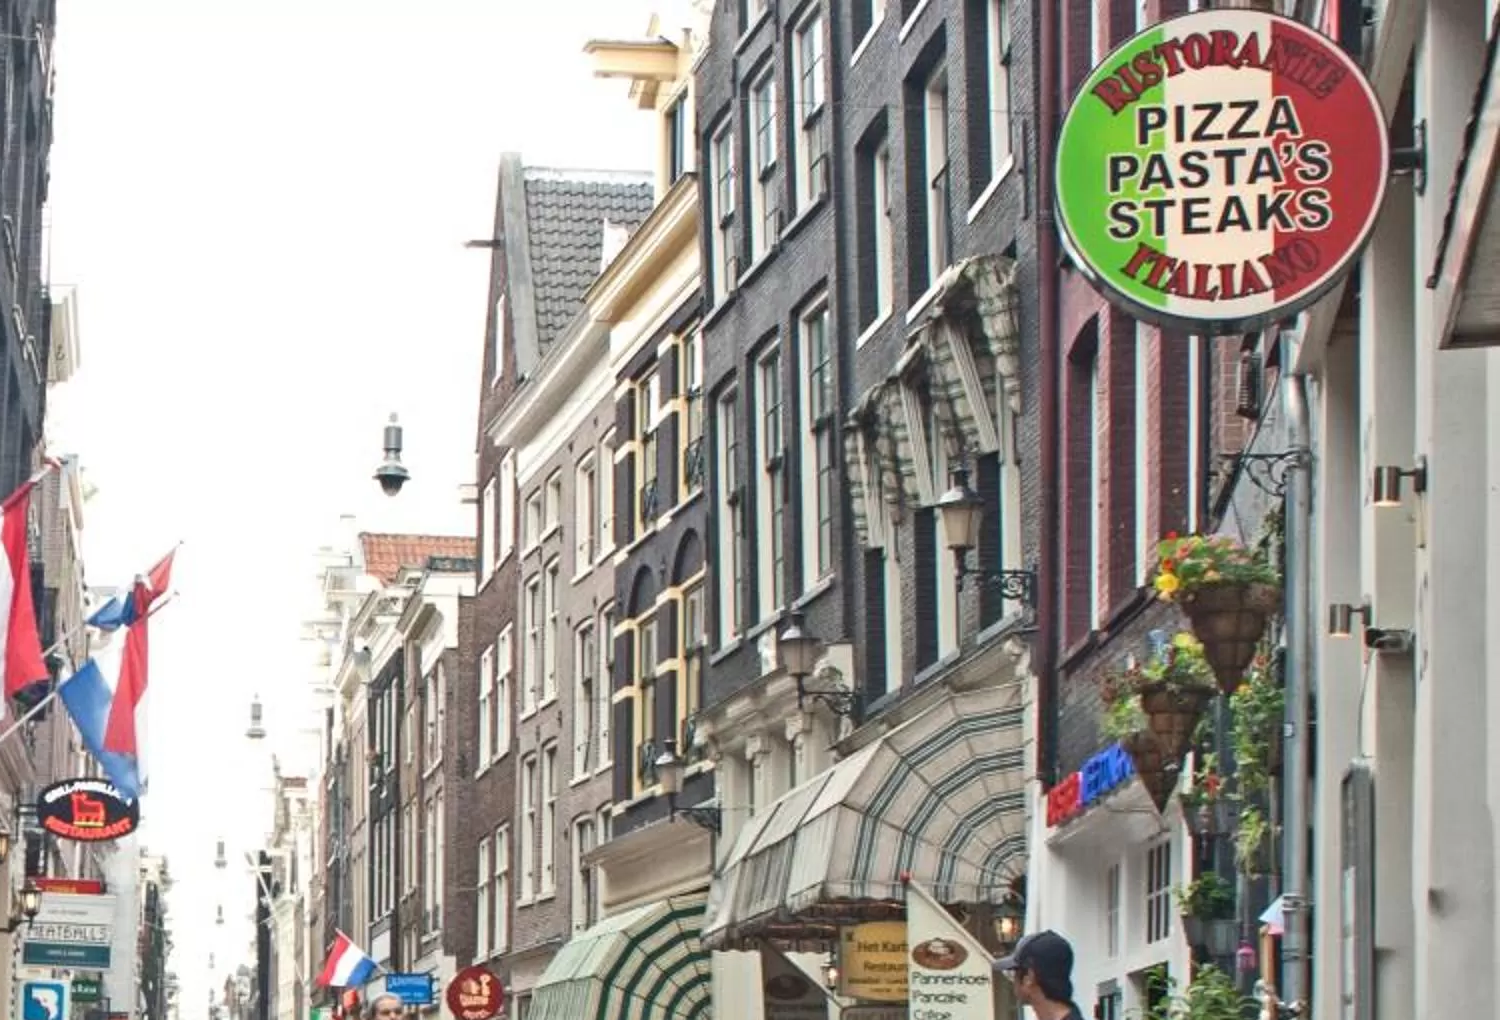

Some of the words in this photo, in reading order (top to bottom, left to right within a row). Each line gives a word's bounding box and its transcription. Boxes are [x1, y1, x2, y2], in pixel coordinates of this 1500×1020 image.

[1091, 30, 1350, 116] RISTORANTE
[1137, 97, 1301, 146] PIZZA
[1108, 142, 1330, 193] PASTA'S
[1107, 191, 1330, 239] STEAKS
[1120, 238, 1321, 302] ITALIANO
[911, 989, 967, 1004] Pancake
